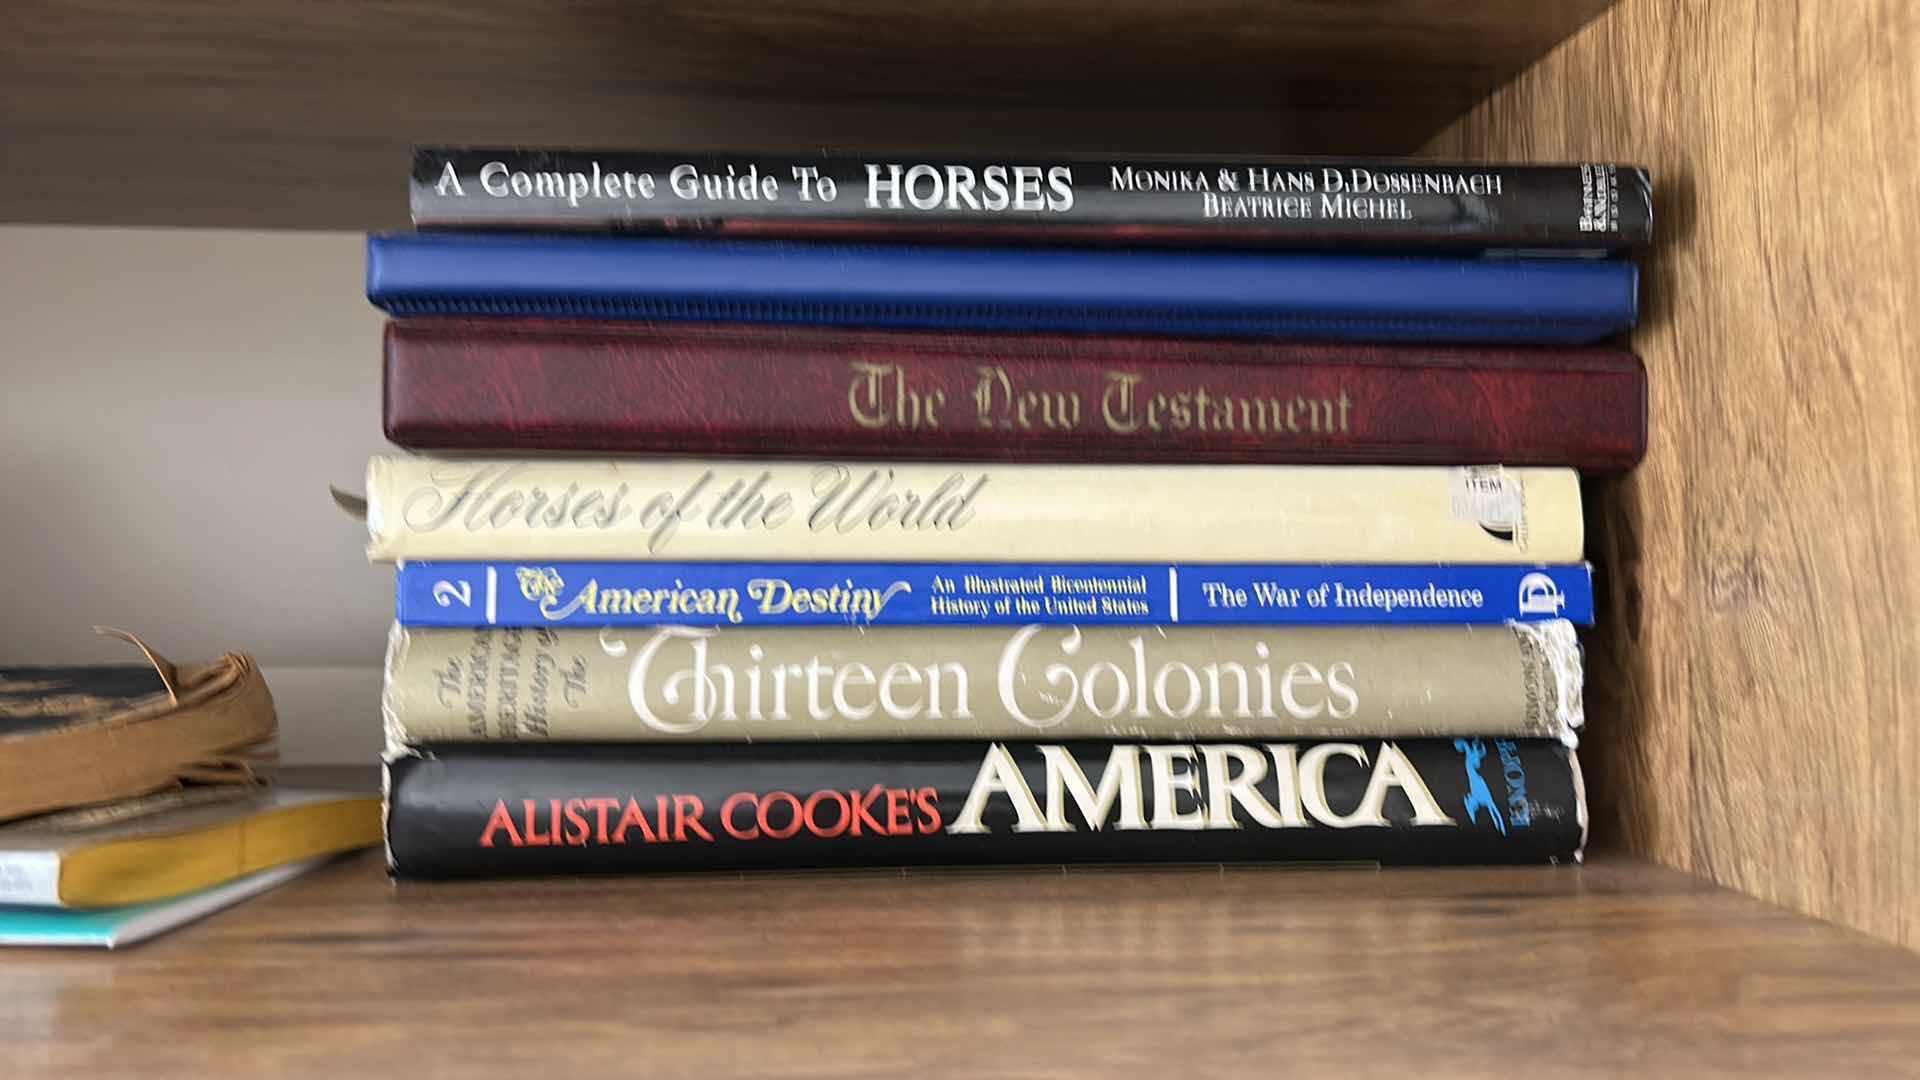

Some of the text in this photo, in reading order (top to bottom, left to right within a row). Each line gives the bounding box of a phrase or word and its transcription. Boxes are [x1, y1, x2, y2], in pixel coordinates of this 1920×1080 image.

[436, 161, 1074, 212] A Complete Guide To HORSES
[1110, 165, 1207, 192] MONIKA
[1217, 168, 1238, 193] &
[1248, 167, 1315, 193] HANS
[1202, 192, 1413, 219] BEATRICE MICHEL
[848, 361, 1353, 434] The New Testament
[403, 462, 989, 553] Horses of the World
[433, 579, 471, 608] 2
[539, 578, 744, 623] American
[747, 578, 912, 620] Destiny
[932, 574, 1147, 595] An Illustrated Bicentennial
[1202, 581, 1484, 612] The War of Independence
[931, 596, 1150, 619] History of the United States
[600, 622, 1359, 734] Thirteen Colonies
[480, 741, 1456, 848] ALISTAIR COOKE'S AMERICA
